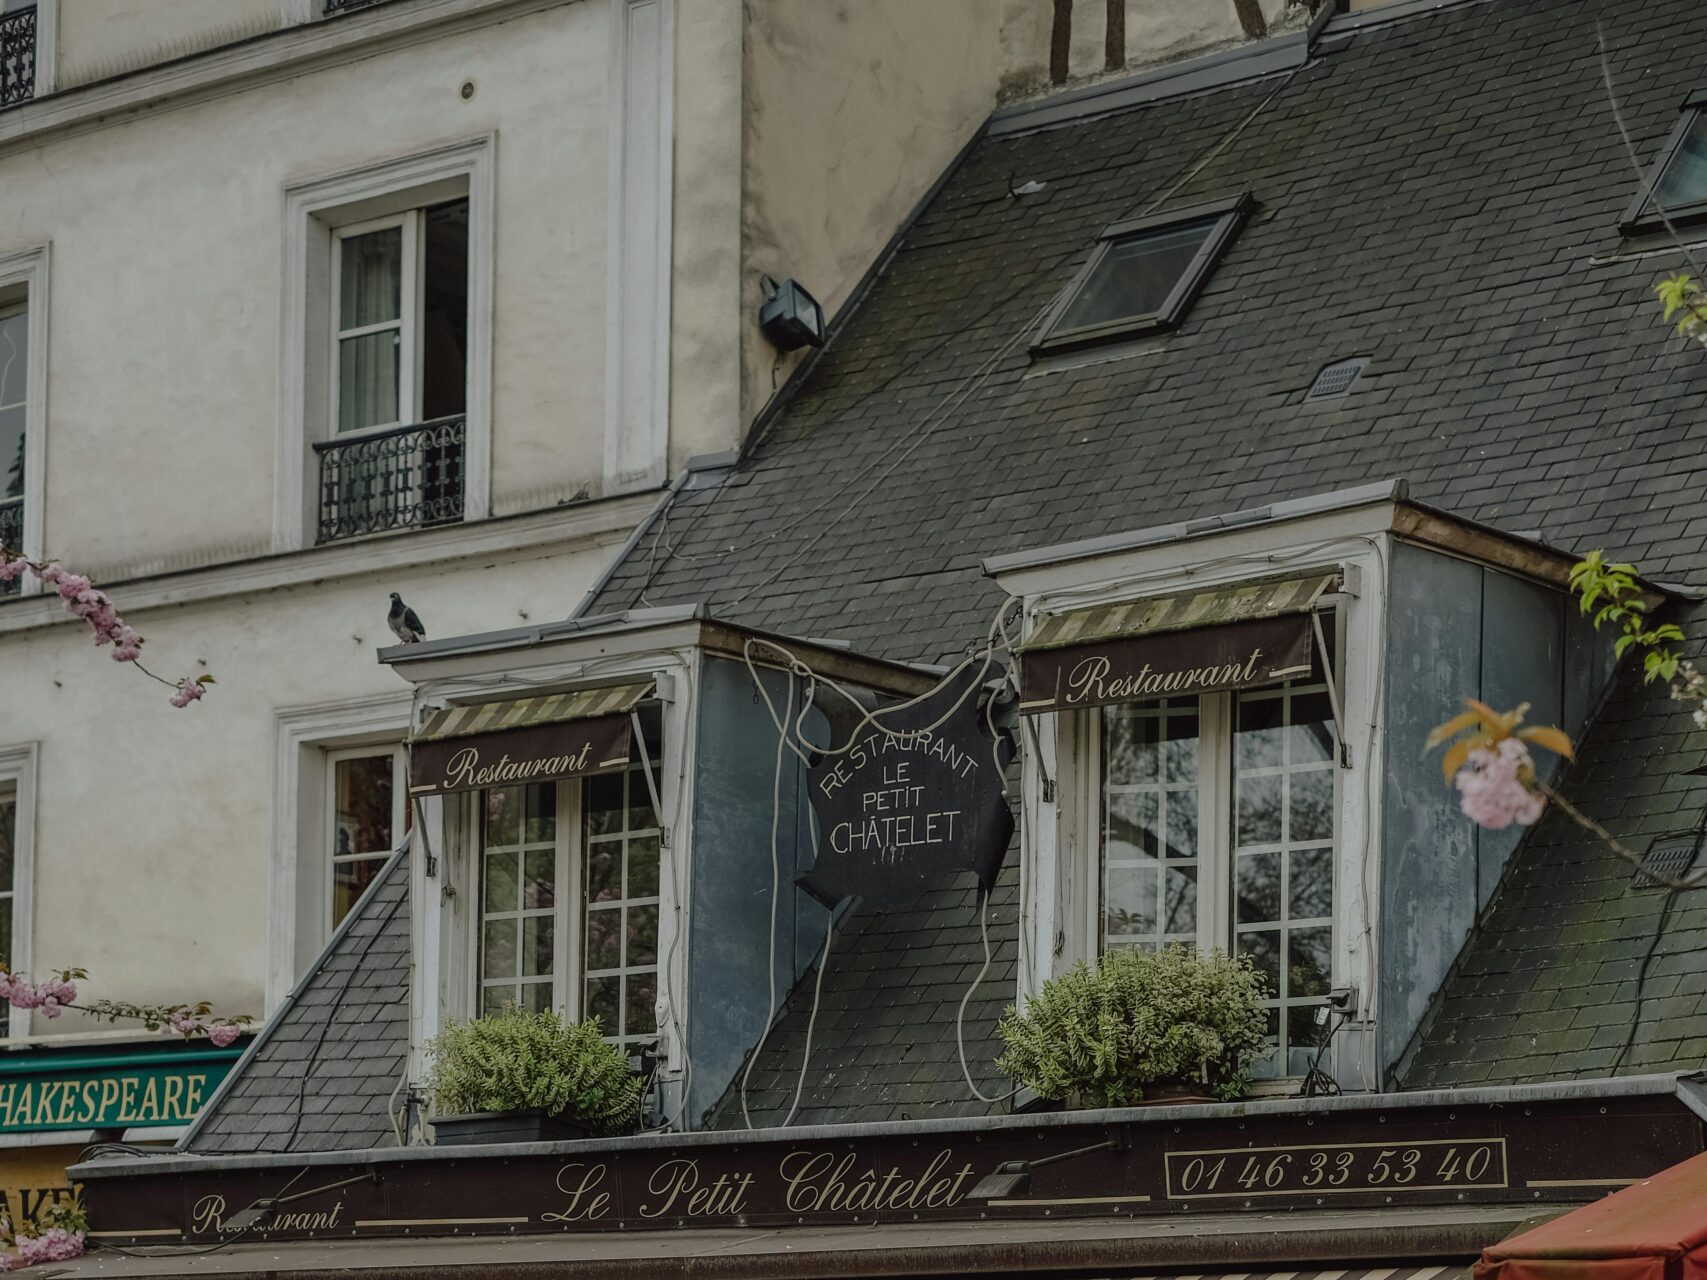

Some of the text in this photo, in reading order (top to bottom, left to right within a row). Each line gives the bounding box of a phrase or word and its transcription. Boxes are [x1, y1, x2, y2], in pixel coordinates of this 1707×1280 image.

[1065, 648, 1264, 703] Restaurant
[442, 741, 593, 789] Restaurant
[819, 728, 980, 800] RESTAURANT
[883, 761, 911, 785] LE
[540, 1148, 975, 1222] Le Petit Châtelet
[1180, 1145, 1491, 1192] 01 46 33 53 40
